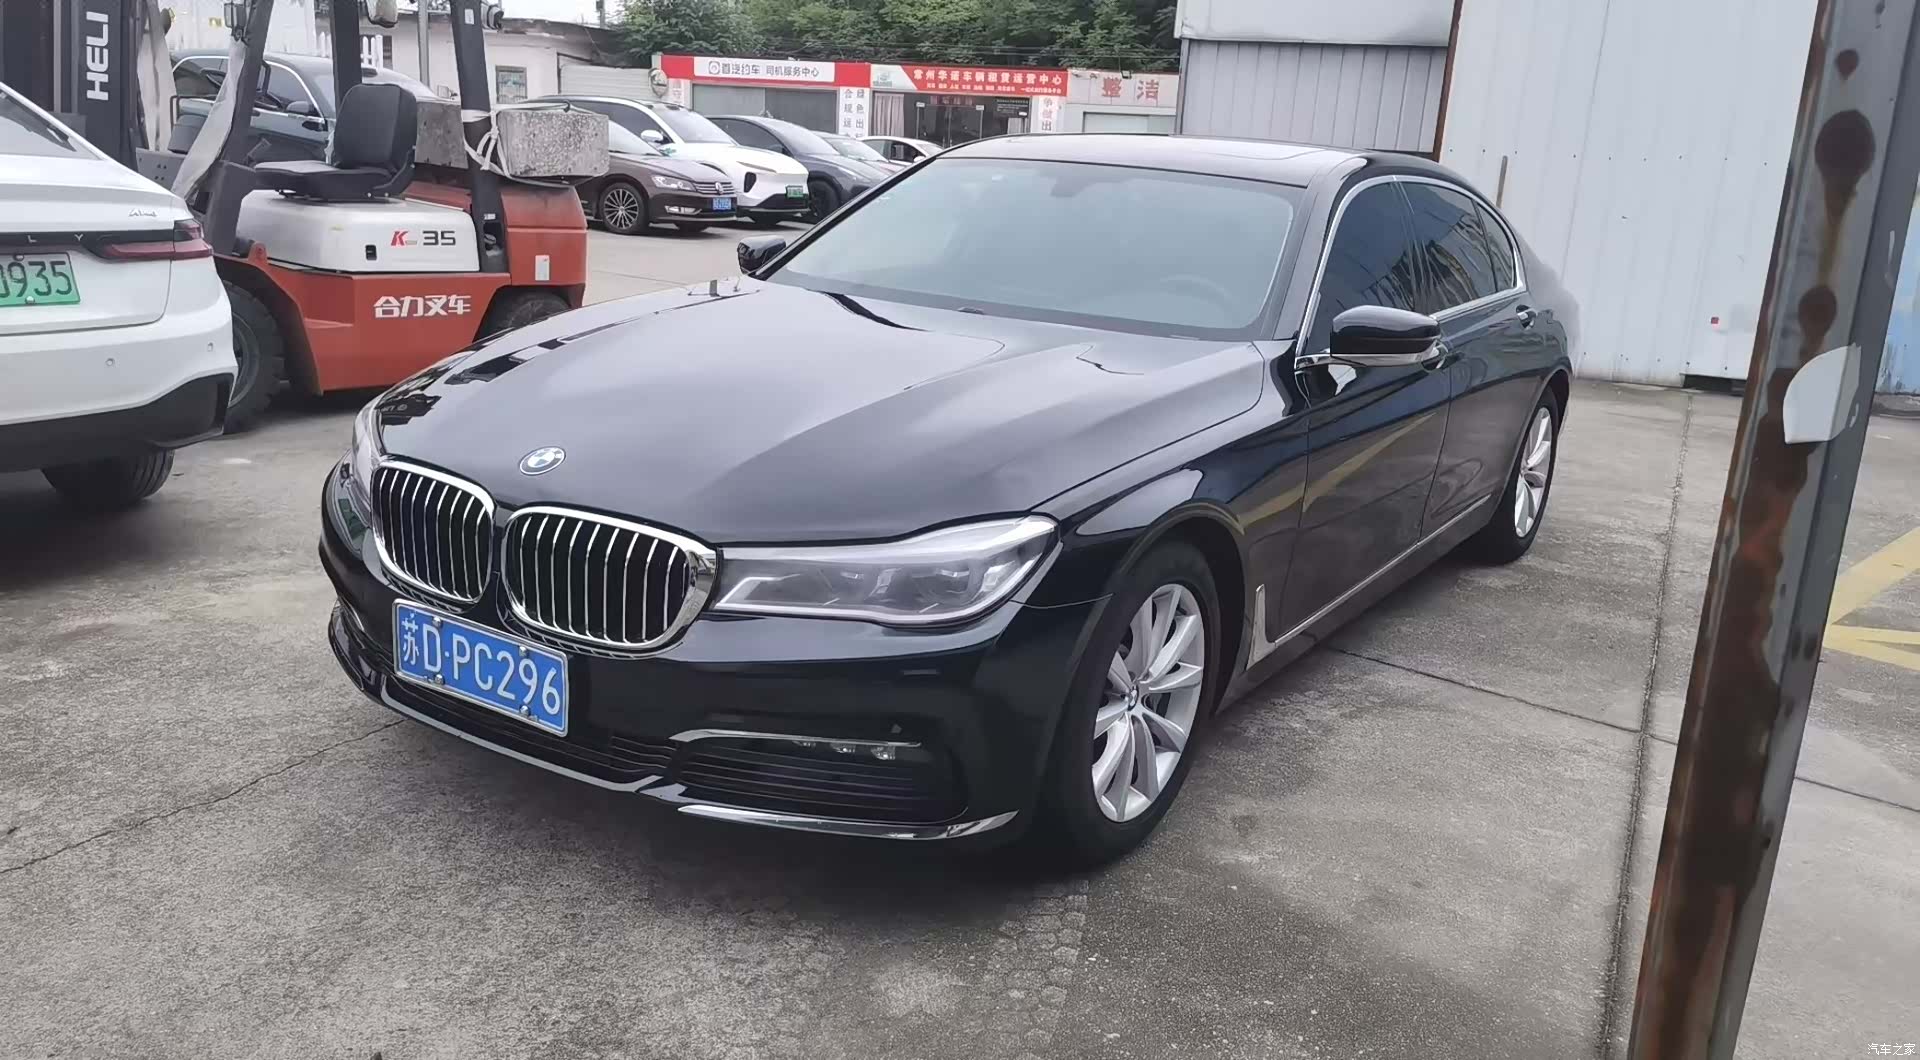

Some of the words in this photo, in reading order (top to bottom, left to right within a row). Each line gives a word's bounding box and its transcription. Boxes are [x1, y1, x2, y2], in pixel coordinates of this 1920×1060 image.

[86, 11, 109, 100] HELI
[721, 62, 760, 76] 首汽约车
[765, 65, 820, 78] 司机服务中心
[1101, 76, 1160, 100] 整洁
[390, 230, 408, 246] K
[422, 230, 456, 246] 35
[374, 295, 471, 318] 合力叉车
